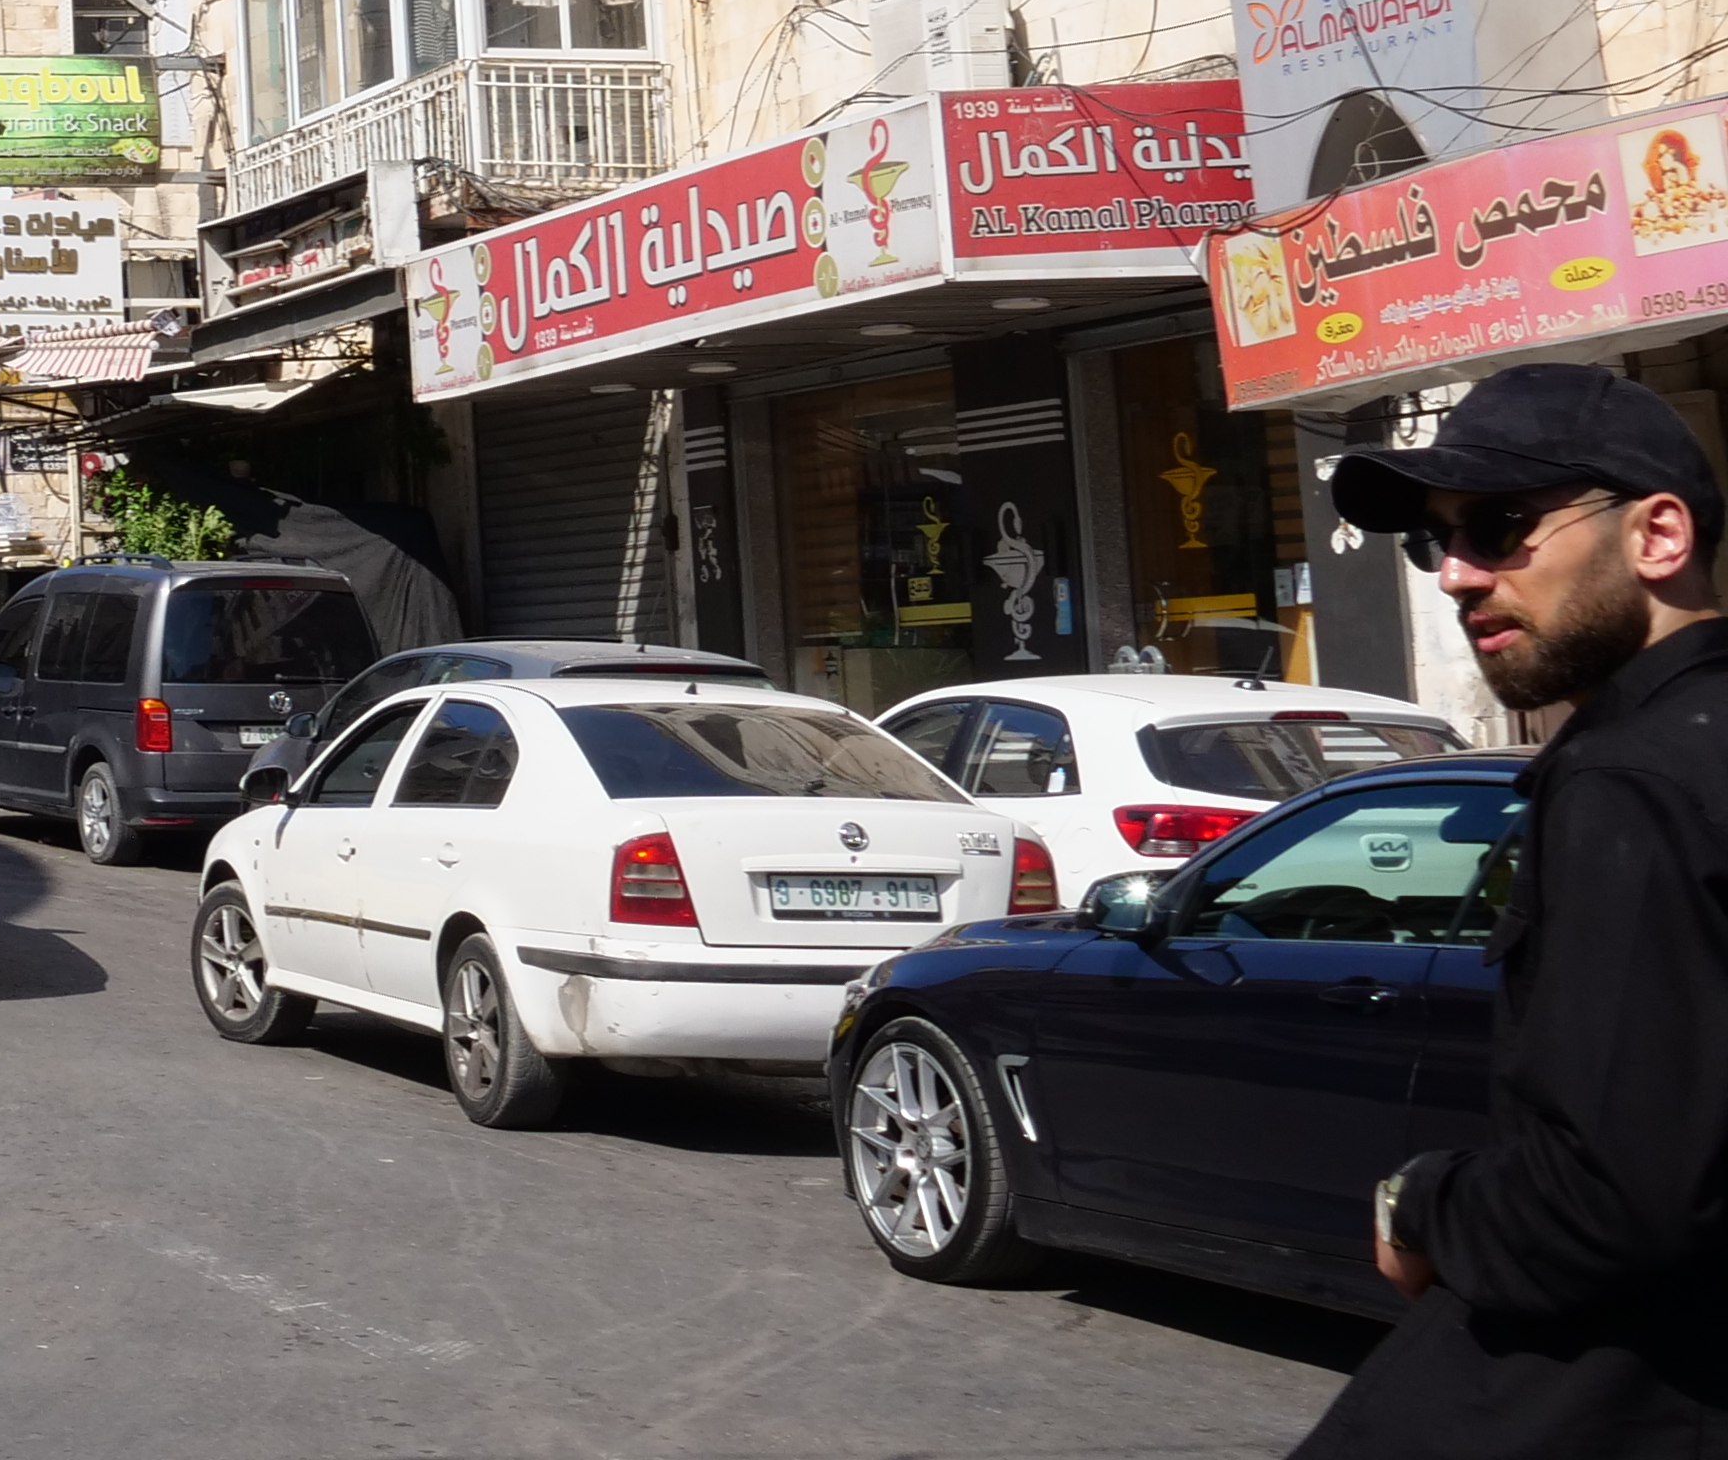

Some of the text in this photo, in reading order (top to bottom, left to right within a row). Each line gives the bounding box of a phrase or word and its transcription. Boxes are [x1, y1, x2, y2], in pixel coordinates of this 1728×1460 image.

[1282, 20, 1453, 76] RESTAURANT
[63, 114, 81, 132] &
[87, 113, 148, 132] Snack
[952, 100, 999, 120] 1939
[1006, 97, 1031, 114] سنة
[959, 120, 1253, 195] يدلية الكمال
[970, 196, 1256, 238] AL Kamal Pharma
[1292, 167, 1607, 307] محمص فلسطين
[500, 184, 798, 353] صيدلية الكمال
[1563, 261, 1604, 284] جملة
[1642, 282, 1728, 318] 0598-459
[534, 327, 557, 350] 1939
